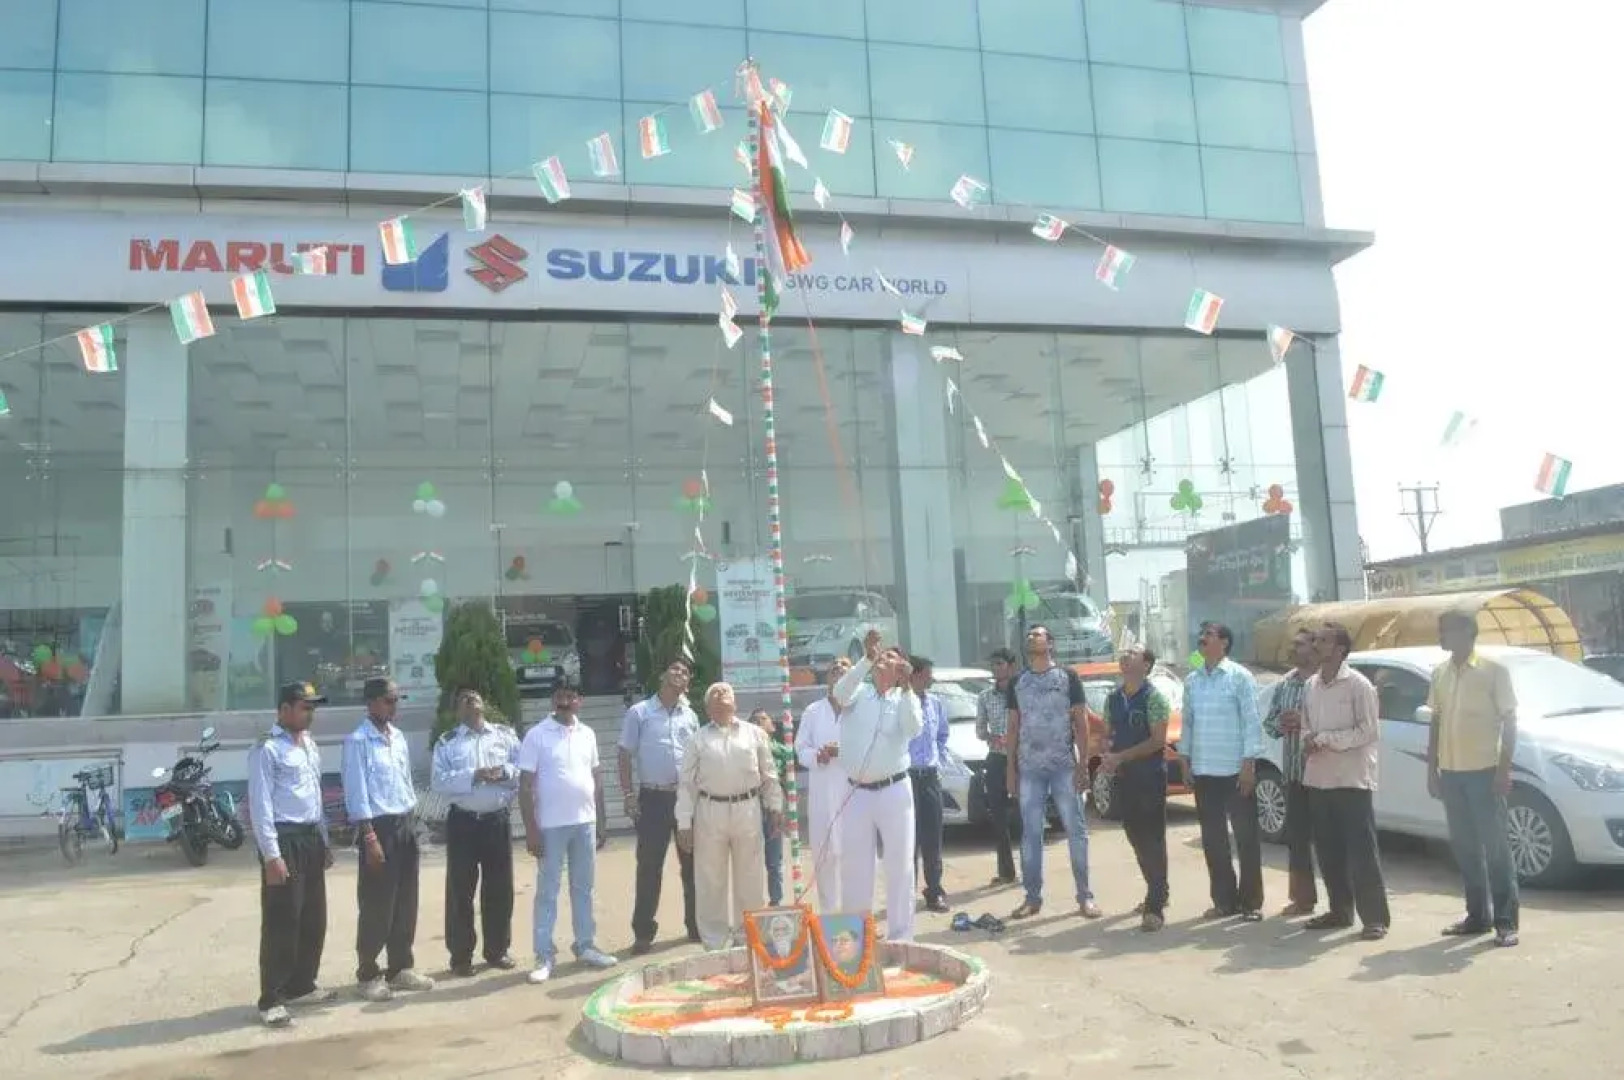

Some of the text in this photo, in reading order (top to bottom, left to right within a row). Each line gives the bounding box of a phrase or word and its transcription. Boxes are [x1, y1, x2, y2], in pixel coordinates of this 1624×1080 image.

[129, 239, 756, 287] MARUTI SUZUKI
[834, 275, 874, 293] CAR
[878, 277, 948, 296] WORLD
